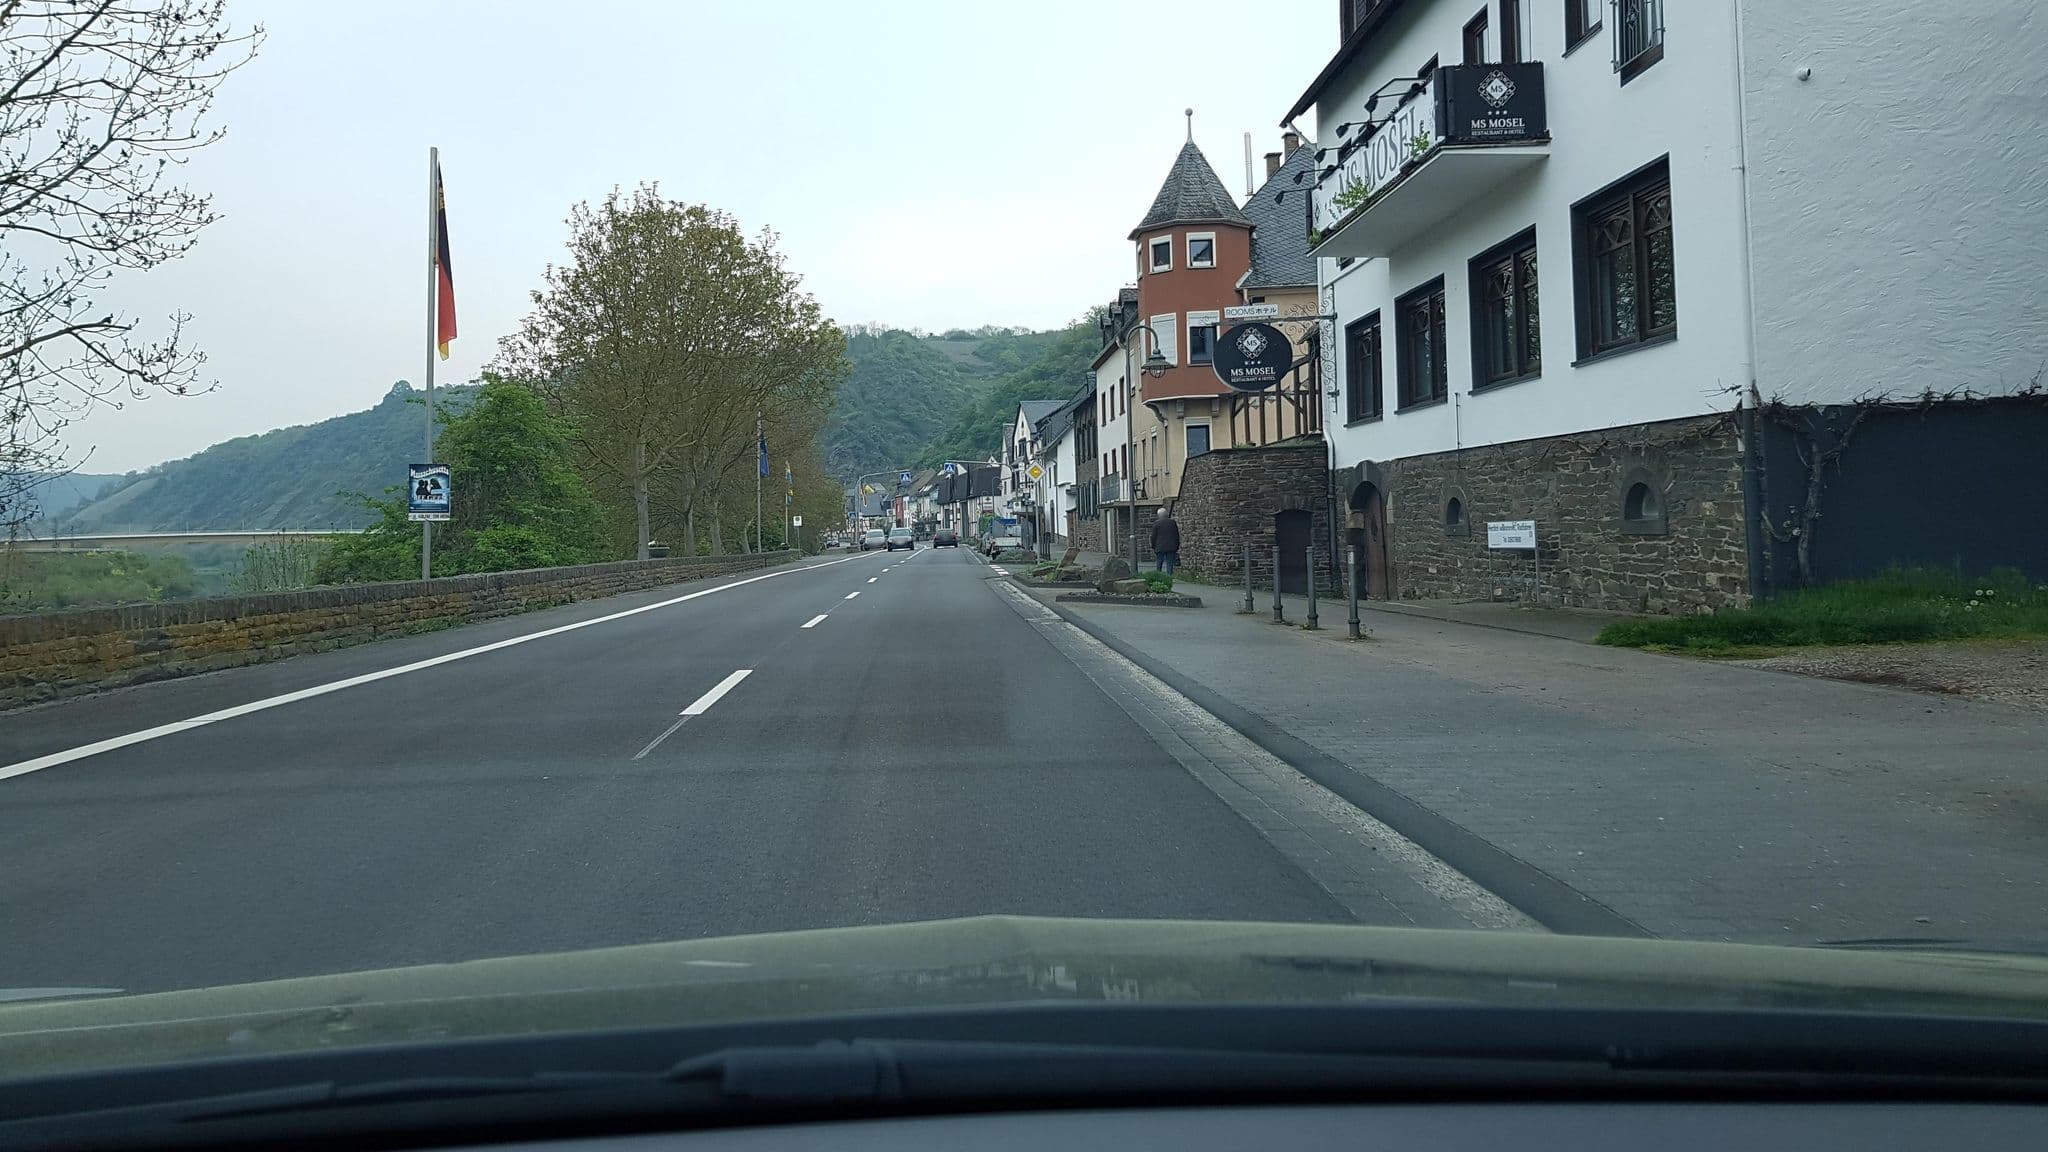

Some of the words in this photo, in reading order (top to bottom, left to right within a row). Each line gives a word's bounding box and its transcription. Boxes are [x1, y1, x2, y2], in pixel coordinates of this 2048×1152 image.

[1490, 85, 1503, 93] MS
[1471, 119, 1486, 129] MS
[1489, 118, 1525, 128] MOSEL
[1363, 106, 1419, 194] MOSEL
[1230, 368, 1244, 377] MS
[1245, 367, 1276, 376] MOSEL
